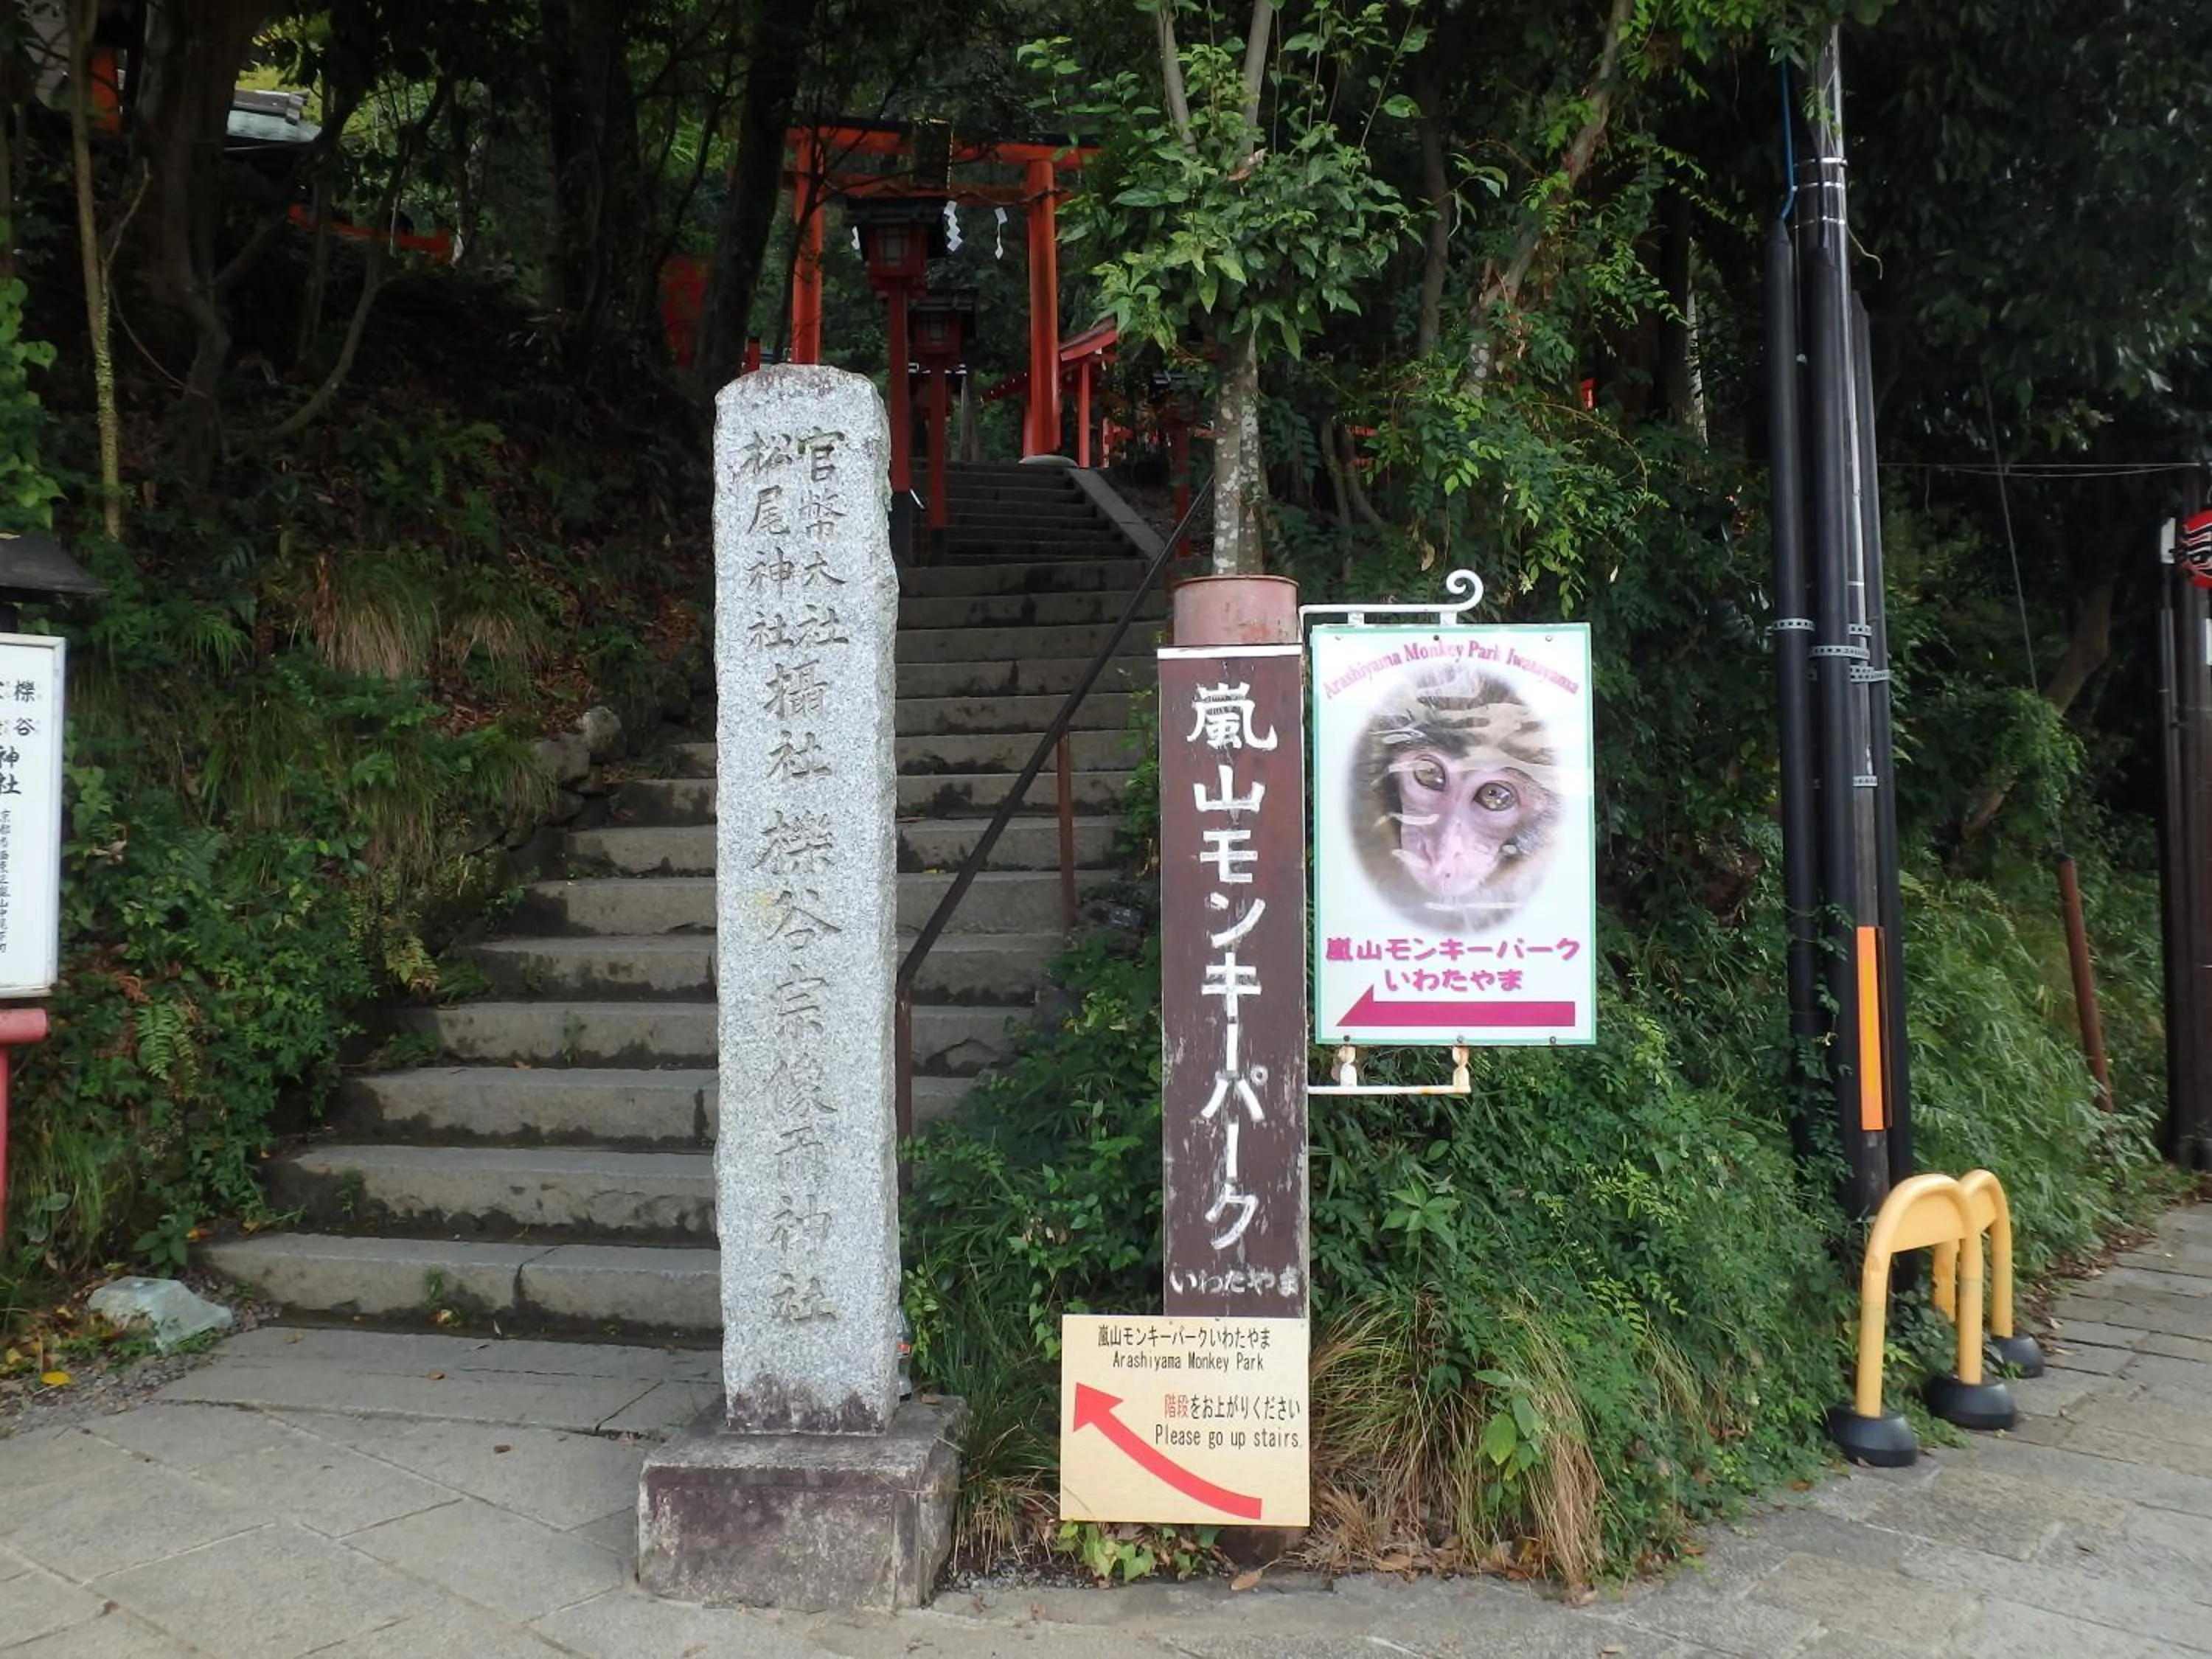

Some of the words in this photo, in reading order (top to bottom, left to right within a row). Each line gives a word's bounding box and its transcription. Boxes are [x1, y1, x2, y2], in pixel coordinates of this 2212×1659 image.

[1323, 650, 1402, 700] Arashiyama
[1403, 641, 1464, 664] Monkey
[1468, 639, 1500, 661] Park
[1506, 647, 1580, 695] Iwatayama
[1186, 682, 1278, 1251] 嵐山モンキーパーク
[1384, 968, 1524, 992] いわたやま
[1169, 1265, 1300, 1298] いわたやま
[1113, 1351, 1181, 1371] Arashiyama
[1188, 1352, 1229, 1372] Monkey
[1237, 1352, 1263, 1369] Park
[1164, 1394, 1301, 1420] 階段をお上がりください
[1155, 1424, 1201, 1445] Please
[1208, 1430, 1223, 1449] go
[1231, 1431, 1245, 1448] up
